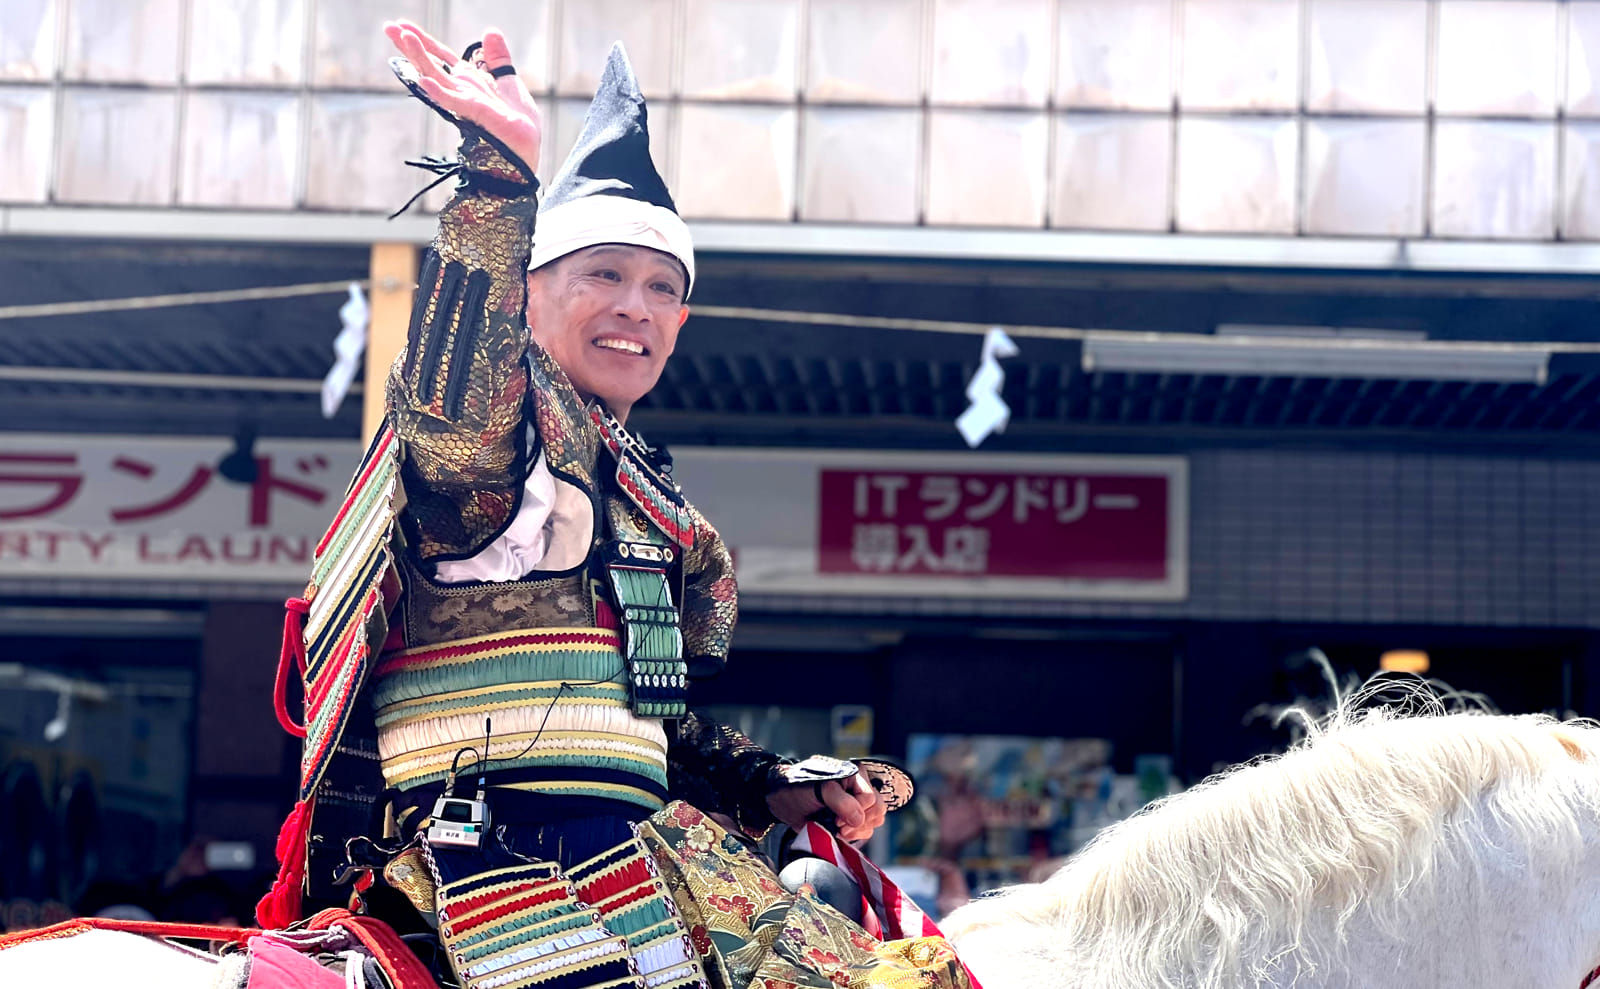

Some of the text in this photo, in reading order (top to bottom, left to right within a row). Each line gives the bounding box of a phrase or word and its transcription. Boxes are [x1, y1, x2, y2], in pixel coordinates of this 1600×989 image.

[853, 475, 1139, 523] IT ランドリー
[137, 534, 320, 565] LAUN
